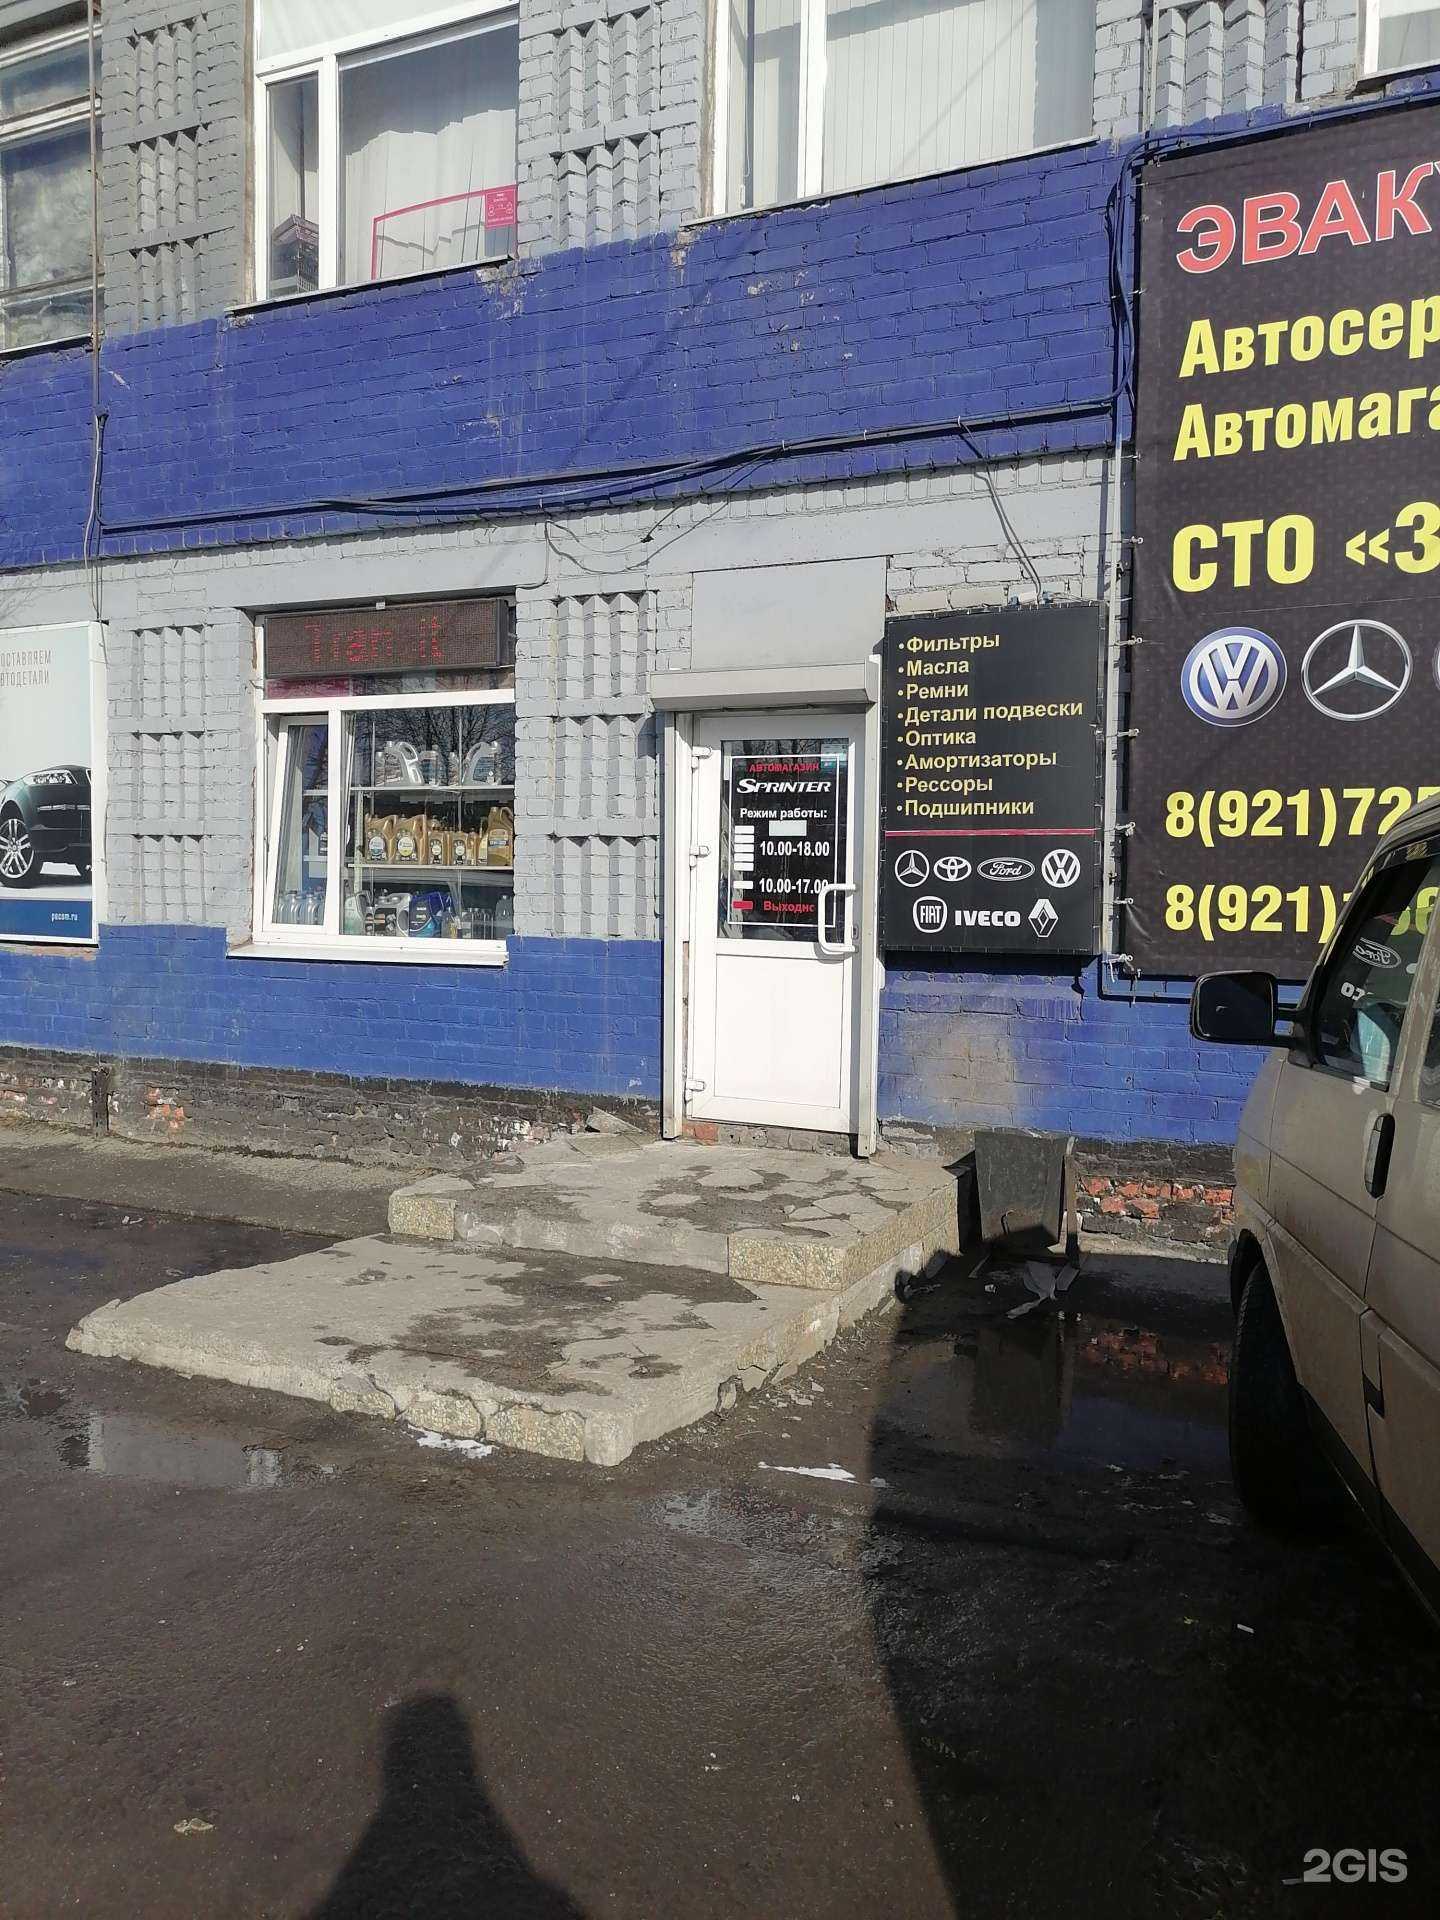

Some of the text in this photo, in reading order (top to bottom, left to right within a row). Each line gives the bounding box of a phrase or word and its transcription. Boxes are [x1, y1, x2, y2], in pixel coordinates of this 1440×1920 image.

[1176, 160, 1440, 273] ЭВАК
[1179, 294, 1440, 378] Автосер
[1172, 514, 1315, 593] СТО
[906, 633, 1000, 653] Фильтры
[906, 658, 969, 675] Масла
[906, 681, 969, 699] Ремни
[904, 702, 1083, 725] Детали подвески
[905, 729, 977, 746] Оптика
[748, 763, 819, 773] АВТОМАГАЗИН
[904, 752, 1057, 771] Амортизаторы
[736, 778, 831, 794] SPRINTER
[905, 776, 993, 795] Рессоры
[740, 808, 828, 822] Режим работы:
[904, 800, 1034, 818] Подшипники
[760, 841, 830, 857] 10.00-18.00
[989, 860, 1023, 877] Ford
[920, 904, 942, 924] FIAT
[954, 909, 1021, 927] IVECO
